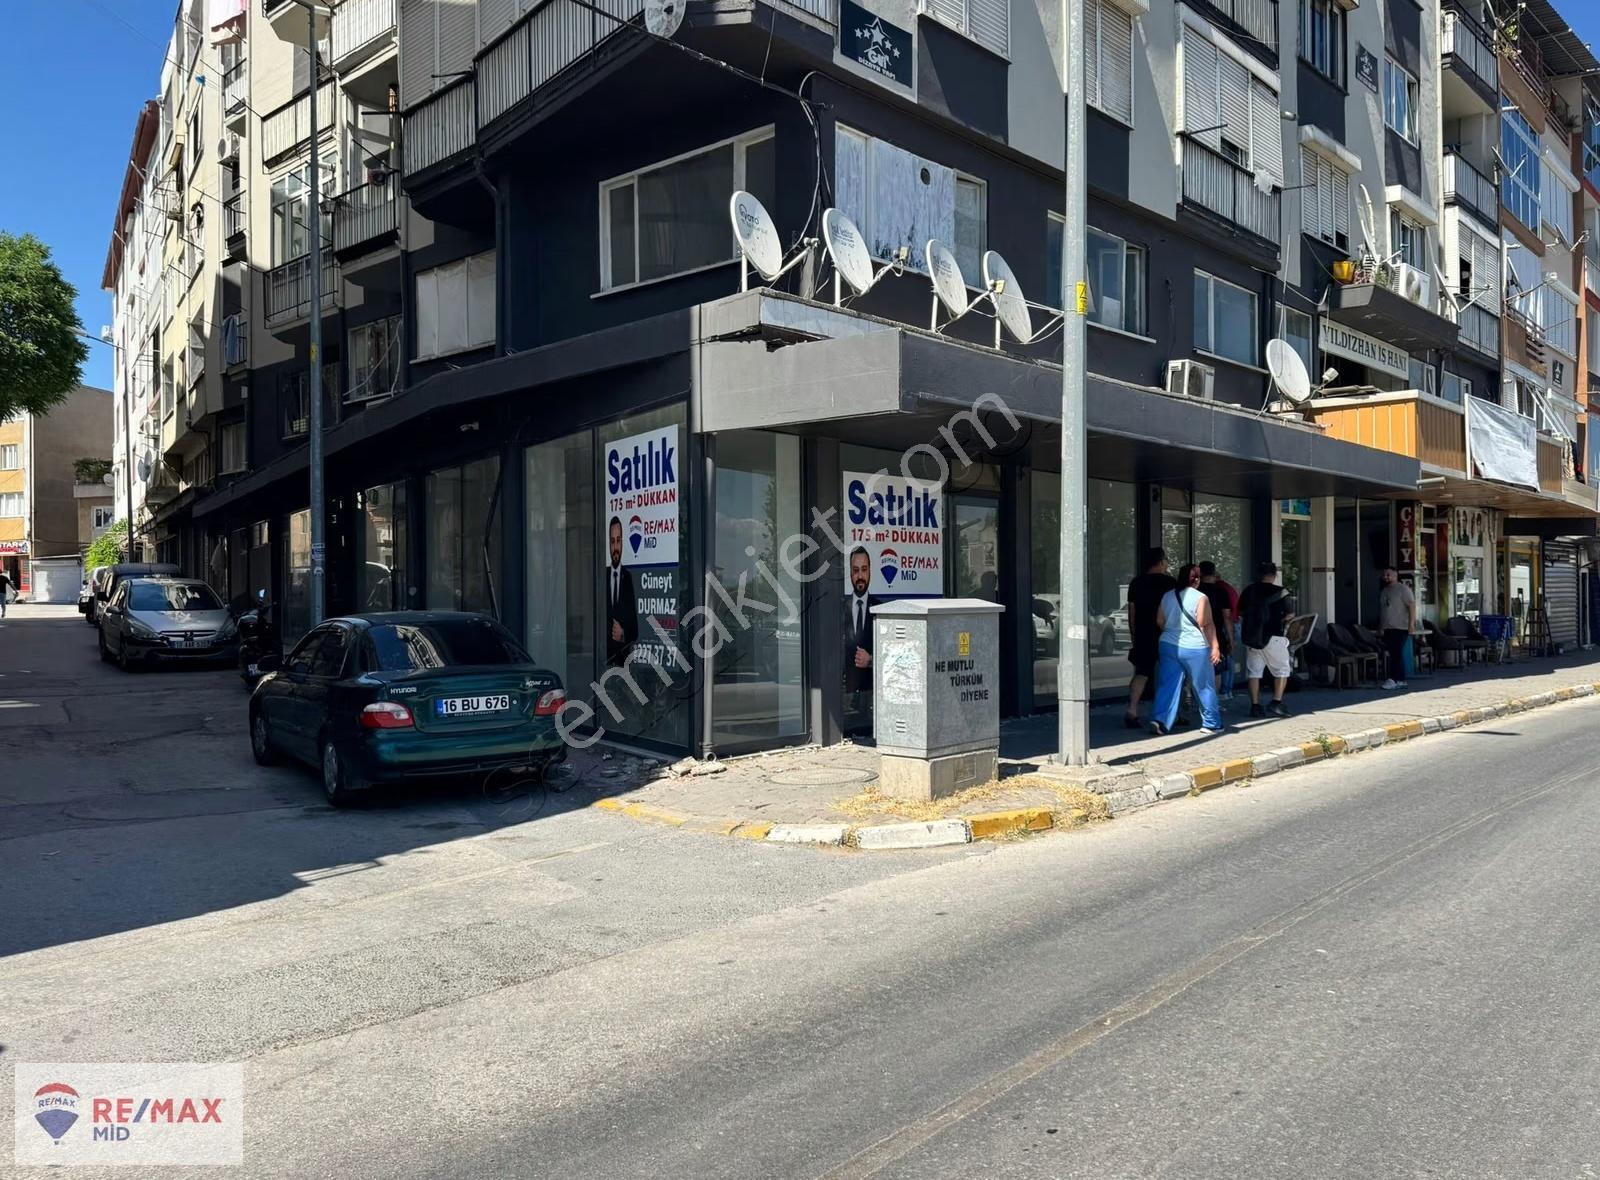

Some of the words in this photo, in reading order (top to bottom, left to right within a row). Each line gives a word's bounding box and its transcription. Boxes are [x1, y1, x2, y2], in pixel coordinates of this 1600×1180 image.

[1322, 324, 1377, 361] YILDIZHAN
[1387, 349, 1407, 373] HANI
[607, 436, 676, 495] Satılık
[610, 497, 623, 512] 175
[637, 487, 676, 508] DÜKKAN
[847, 479, 939, 529] Satılık
[643, 518, 676, 536] RE/MAX
[851, 527, 871, 542] 175
[891, 527, 939, 545] DÜKKAN
[1400, 506, 1413, 563] ÇAY
[901, 556, 939, 569] RE/MAX
[641, 572, 673, 594] Cüneyt
[637, 598, 677, 615] DURMAZ
[653, 644, 665, 666] 37
[666, 645, 678, 668] 37
[934, 661, 946, 673] NE
[947, 660, 974, 672] MUTLU
[950, 673, 983, 687] TÜRKÜM
[443, 699, 457, 713] 16
[461, 698, 480, 712] BU
[485, 696, 508, 711] 676
[960, 689, 989, 702] DİYENE
